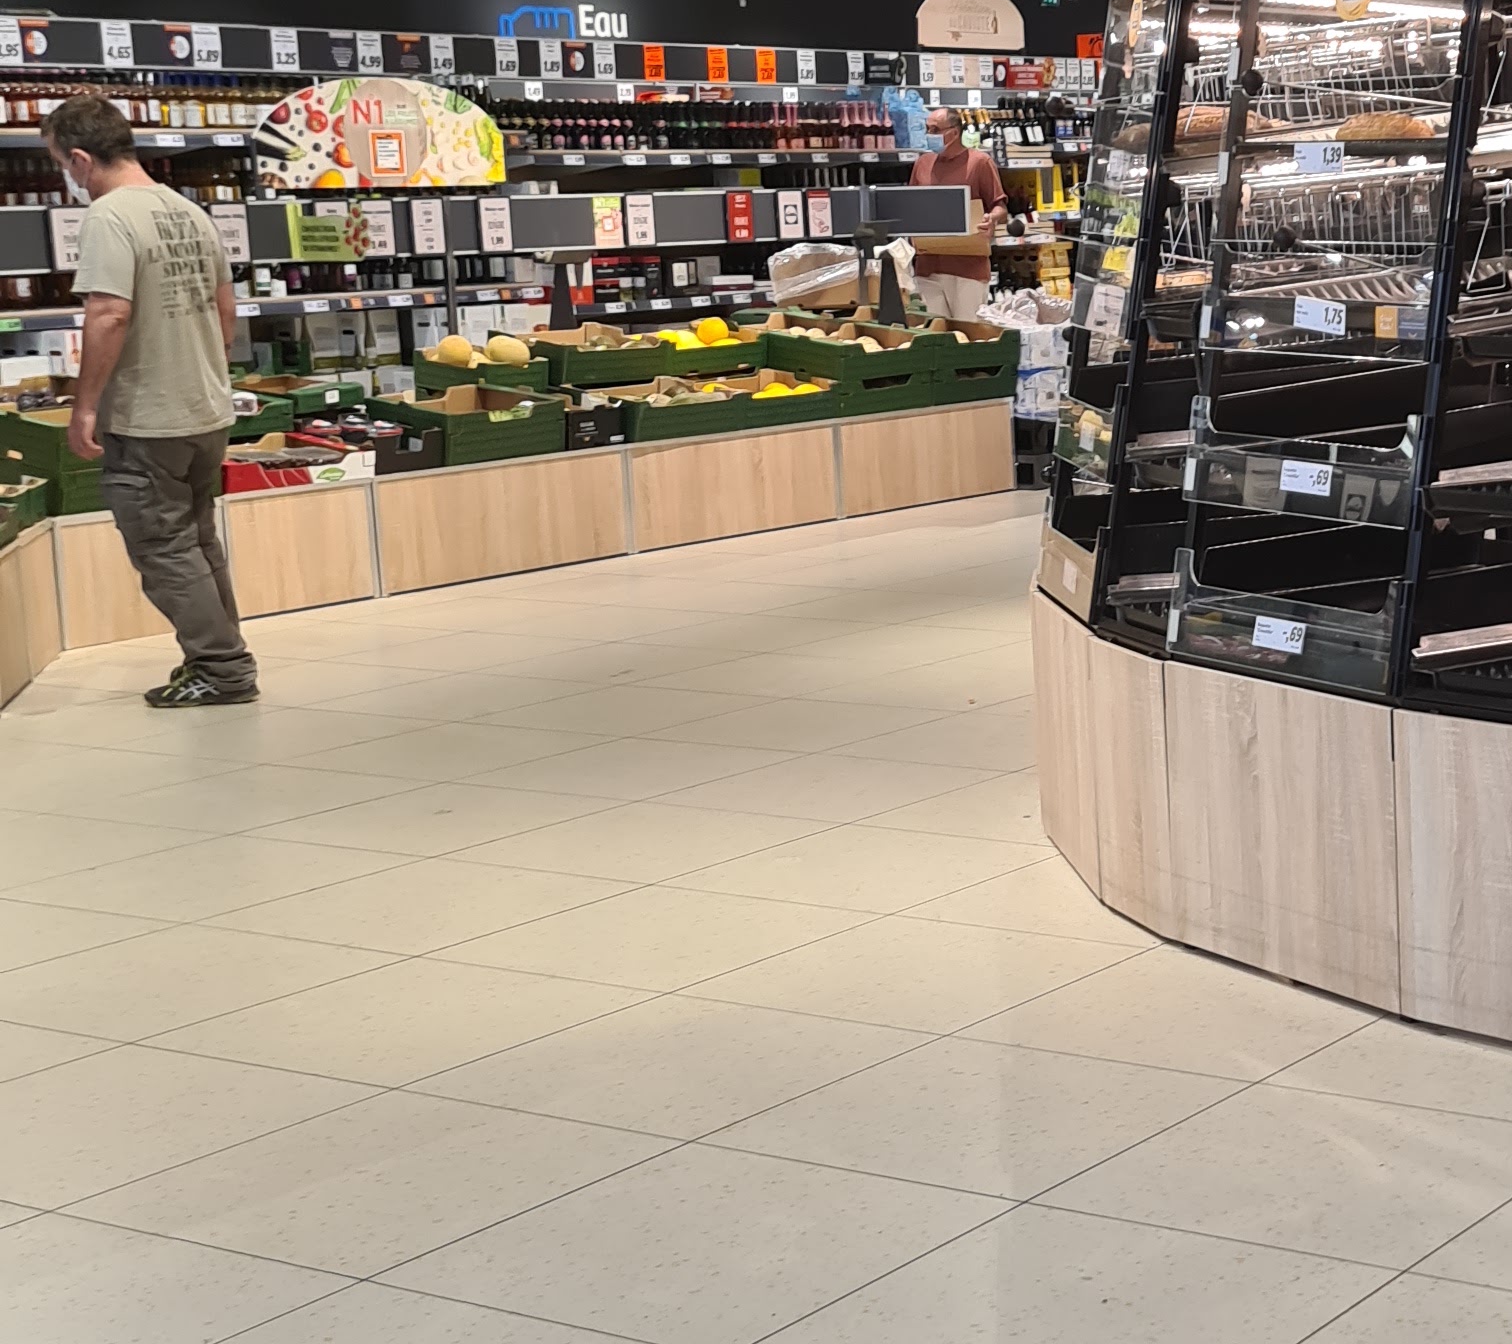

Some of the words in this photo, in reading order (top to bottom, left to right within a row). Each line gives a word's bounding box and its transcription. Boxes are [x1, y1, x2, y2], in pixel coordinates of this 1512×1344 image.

[578, 4, 629, 38] Eau
[1322, 146, 1342, 166] 1,39
[1324, 306, 1344, 326] 1,75
[1308, 469, 1329, 487] -,69
[1282, 626, 1303, 644] -,69
